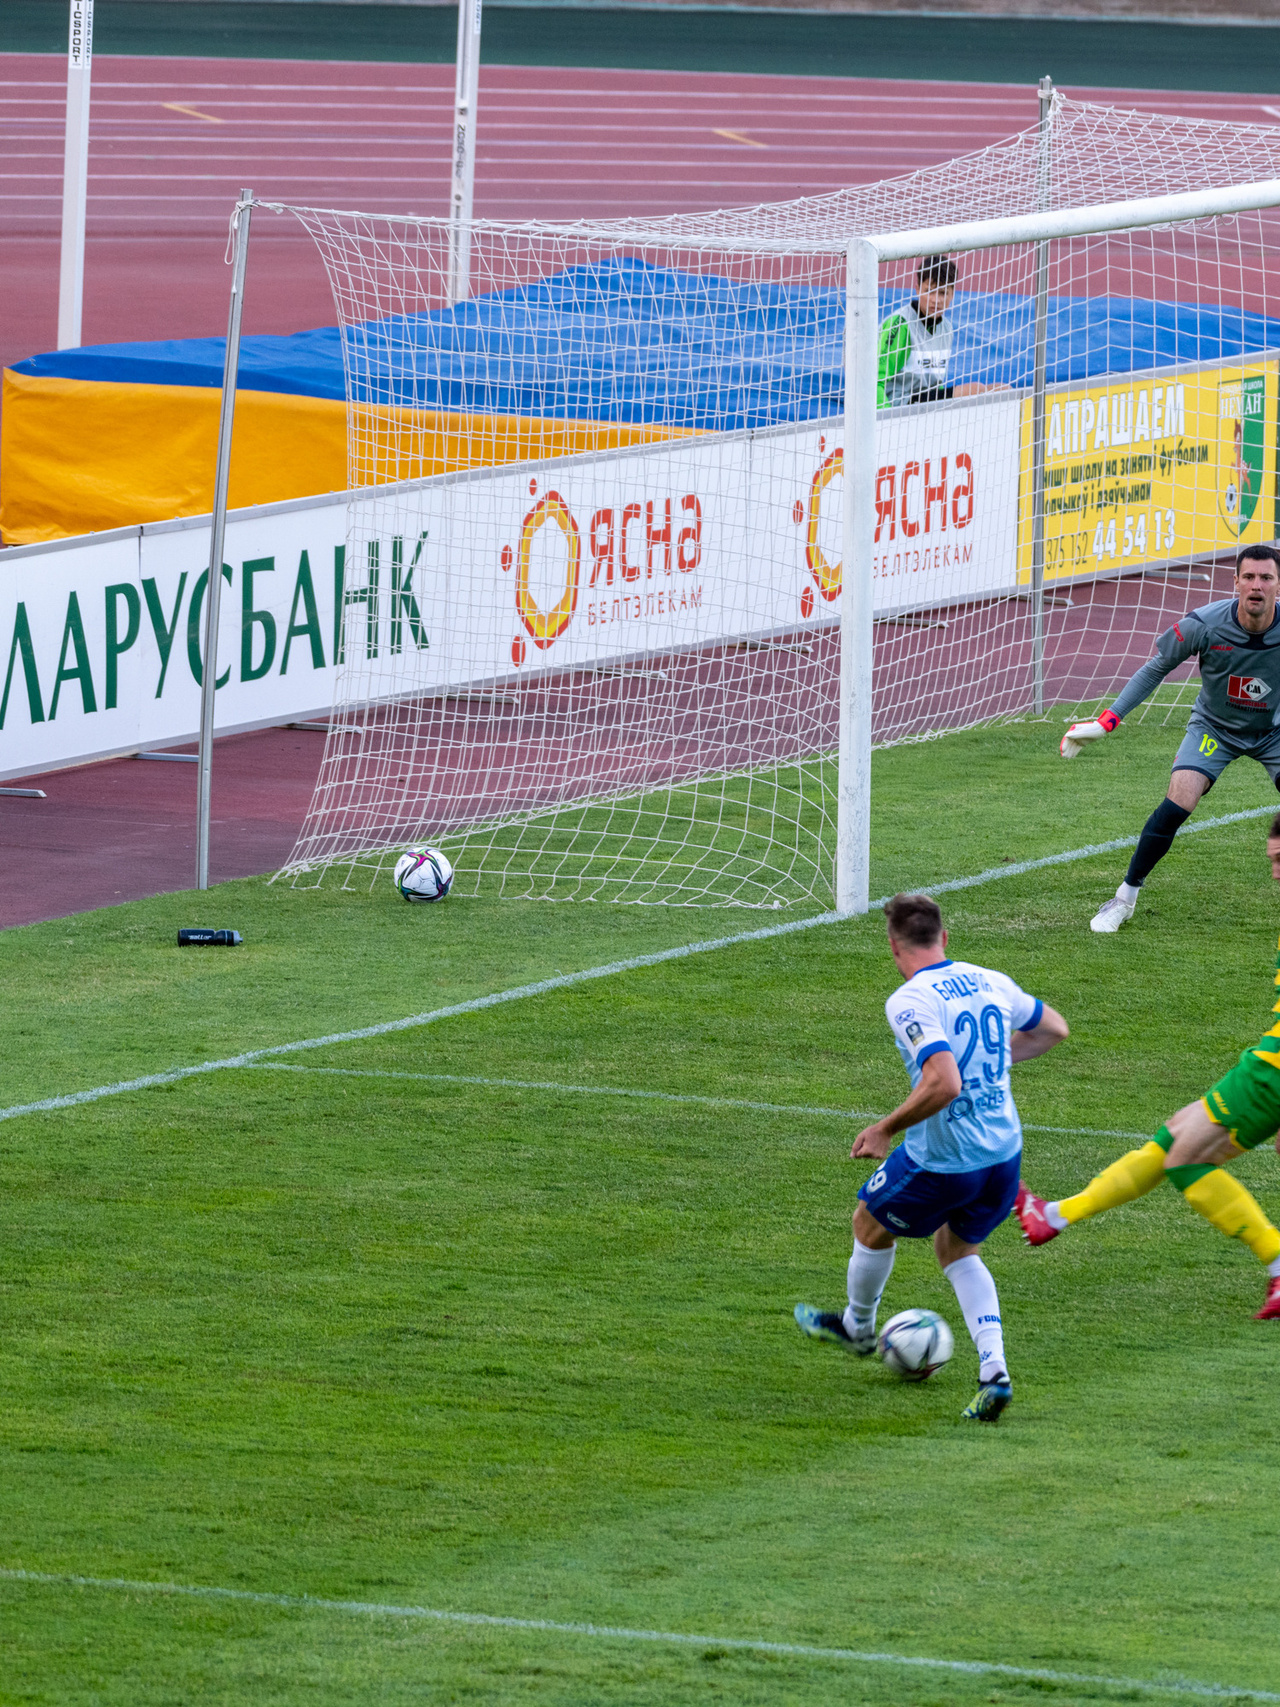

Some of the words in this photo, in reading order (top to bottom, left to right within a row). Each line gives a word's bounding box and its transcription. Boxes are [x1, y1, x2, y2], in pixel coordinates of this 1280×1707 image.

[72, 0, 83, 62] ICSPORT
[1046, 383, 1185, 457] АПРАШАЕМ
[1044, 485, 1089, 519] опчыкаў
[1092, 518, 1117, 561] 44
[1122, 513, 1146, 557] 54
[1154, 508, 1176, 551] 13
[588, 584, 702, 626] БЕЛТЭЛЕКАМ
[1199, 734, 1218, 756] 19
[954, 1004, 1004, 1090] 29
